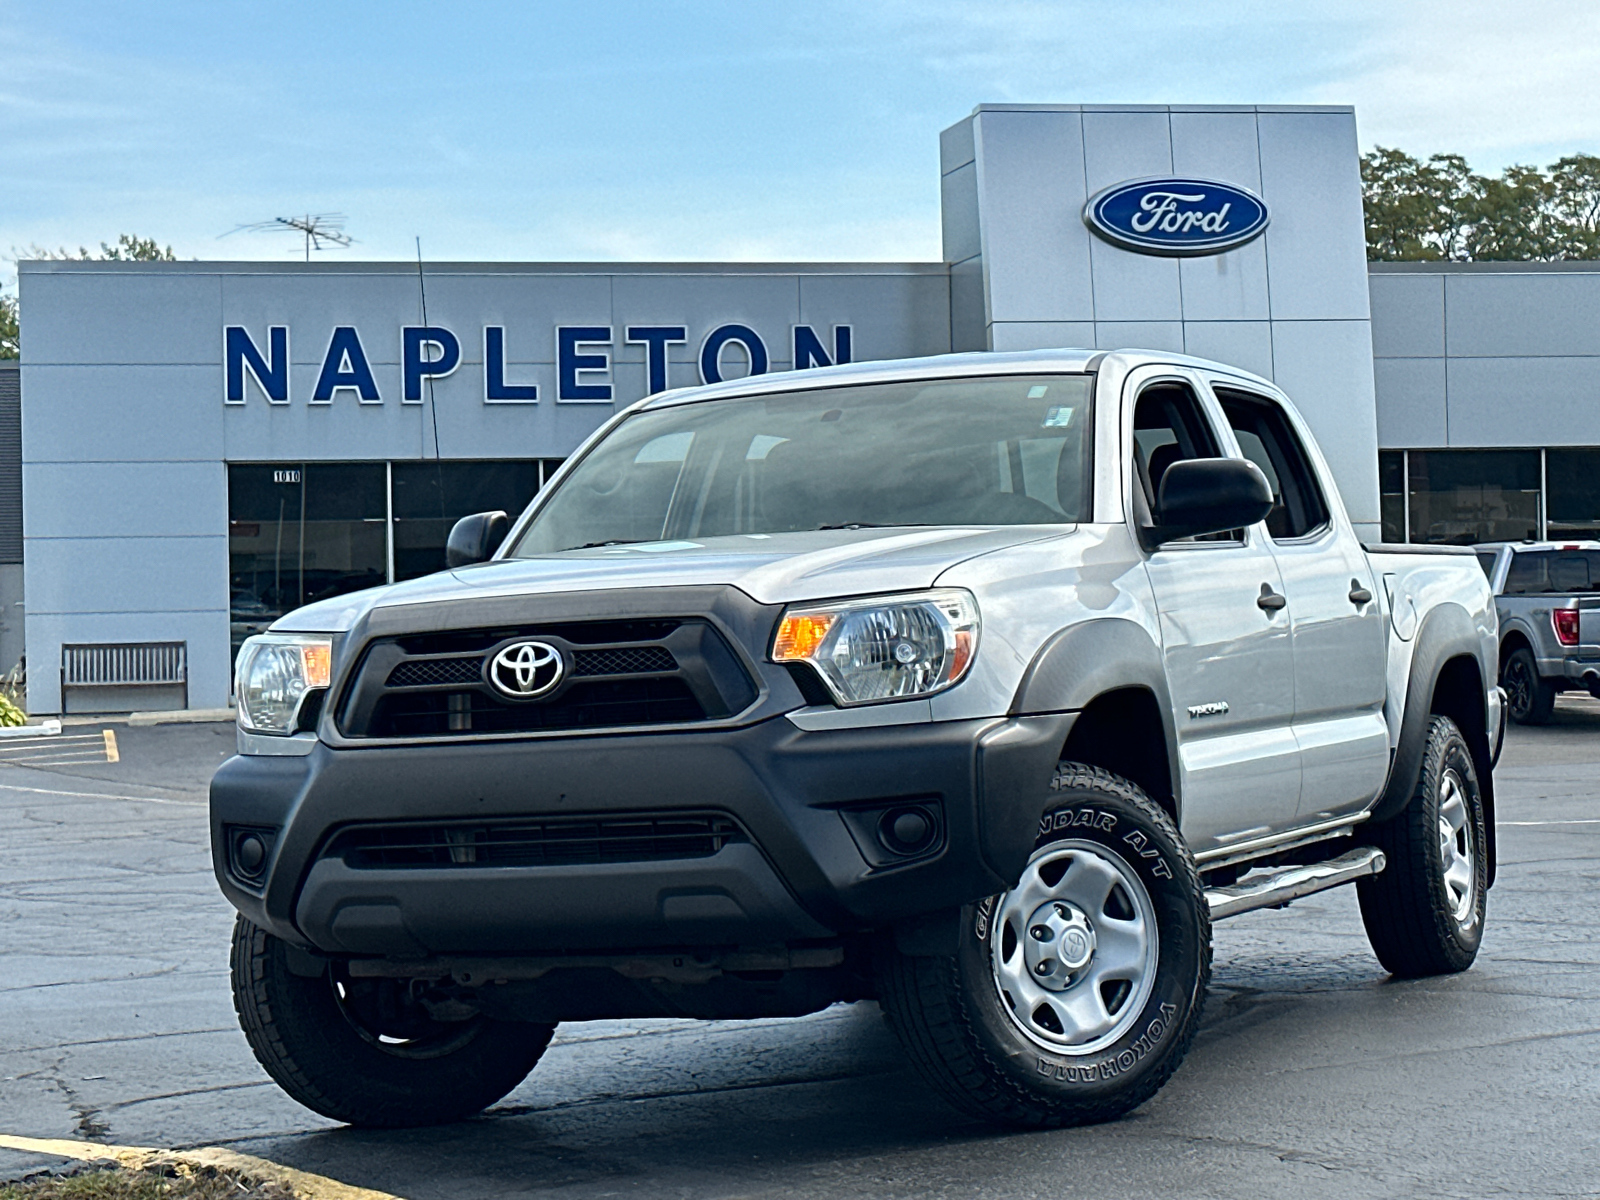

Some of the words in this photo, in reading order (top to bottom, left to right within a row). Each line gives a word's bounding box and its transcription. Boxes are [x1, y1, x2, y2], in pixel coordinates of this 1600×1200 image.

[1131, 192, 1231, 233] Ford
[223, 323, 852, 404] NAPLETON
[275, 471, 299, 482] 1010
[1123, 830, 1173, 880] A/T
[1037, 1002, 1176, 1083] YOKOHAMA
